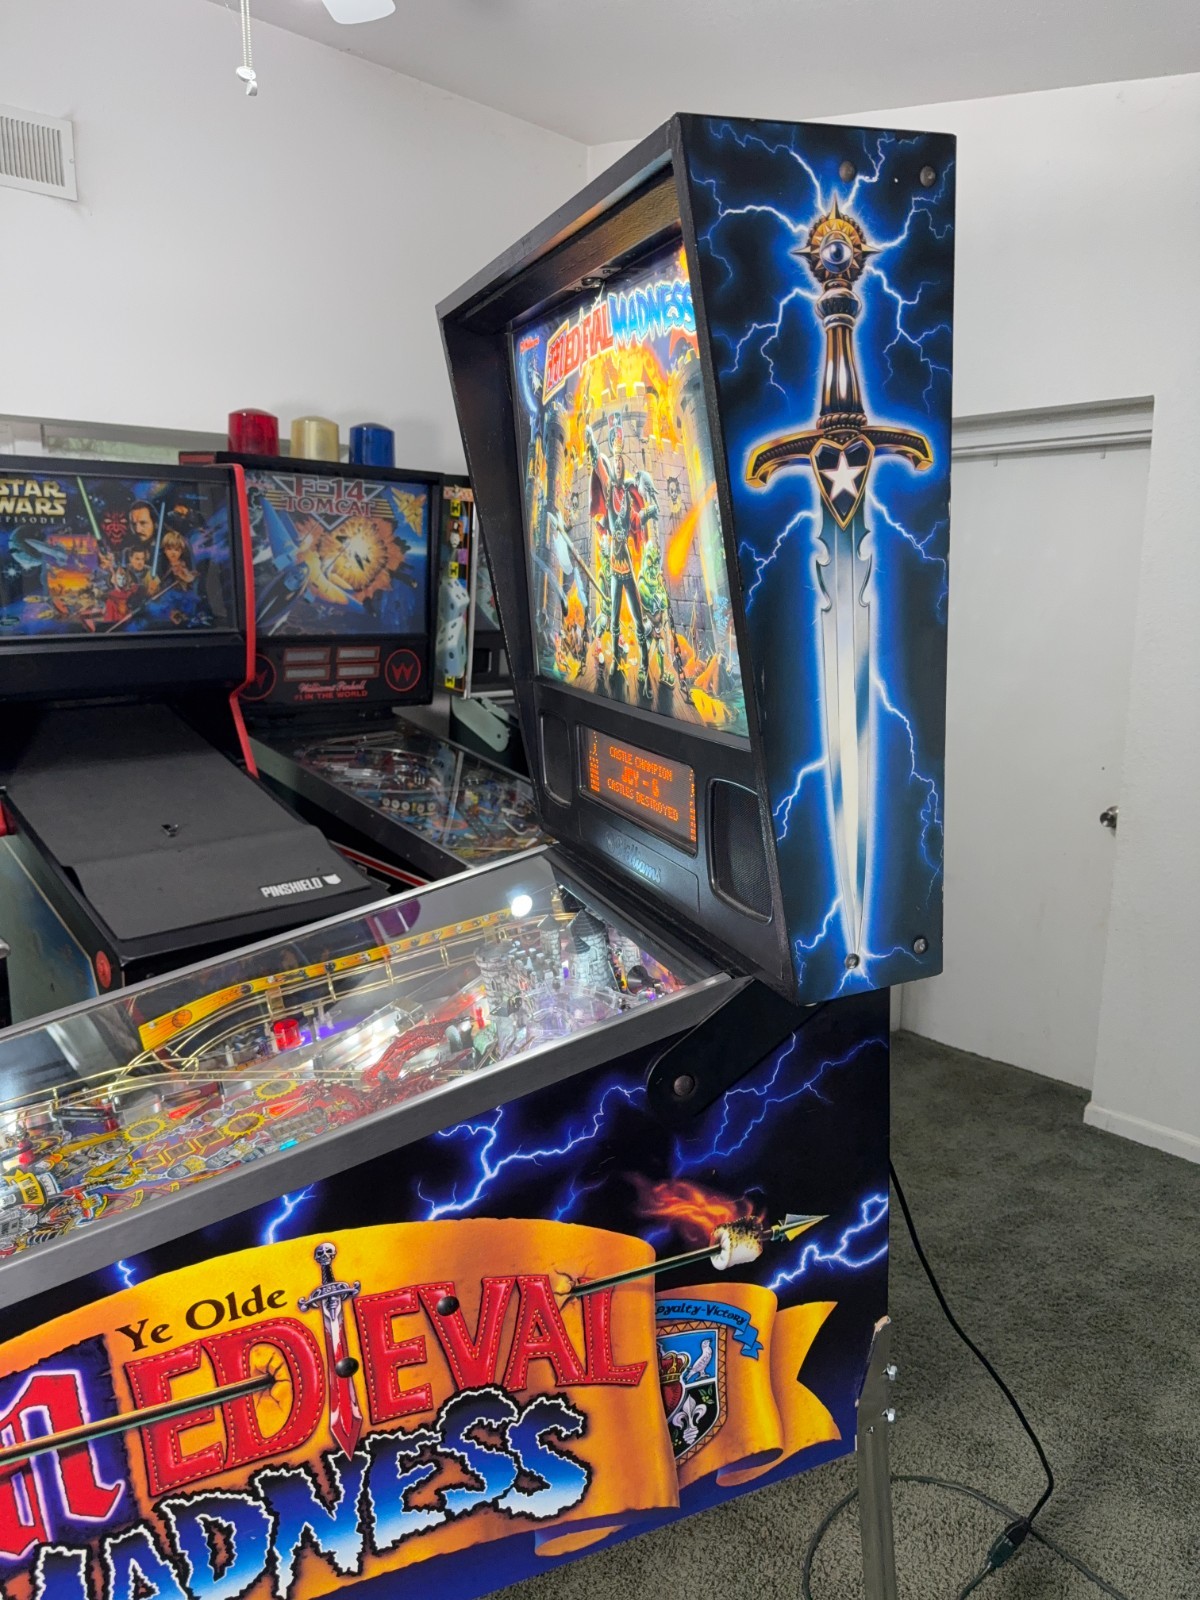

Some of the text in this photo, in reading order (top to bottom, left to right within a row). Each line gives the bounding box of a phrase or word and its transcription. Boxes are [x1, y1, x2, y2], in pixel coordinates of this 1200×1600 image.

[293, 475, 366, 501] F-14
[0, 497, 67, 515] WARS
[282, 495, 376, 518] TOMCAT
[317, 691, 334, 699] THE
[336, 690, 368, 699] WORLD
[609, 746, 673, 782] CASTLE CHAMPION
[607, 778, 679, 822] CASTLES DESTROYED
[260, 876, 324, 898] PINSHIELD
[115, 1284, 287, 1352] Ye Olde
[655, 1303, 747, 1326] oyalty-Victory
